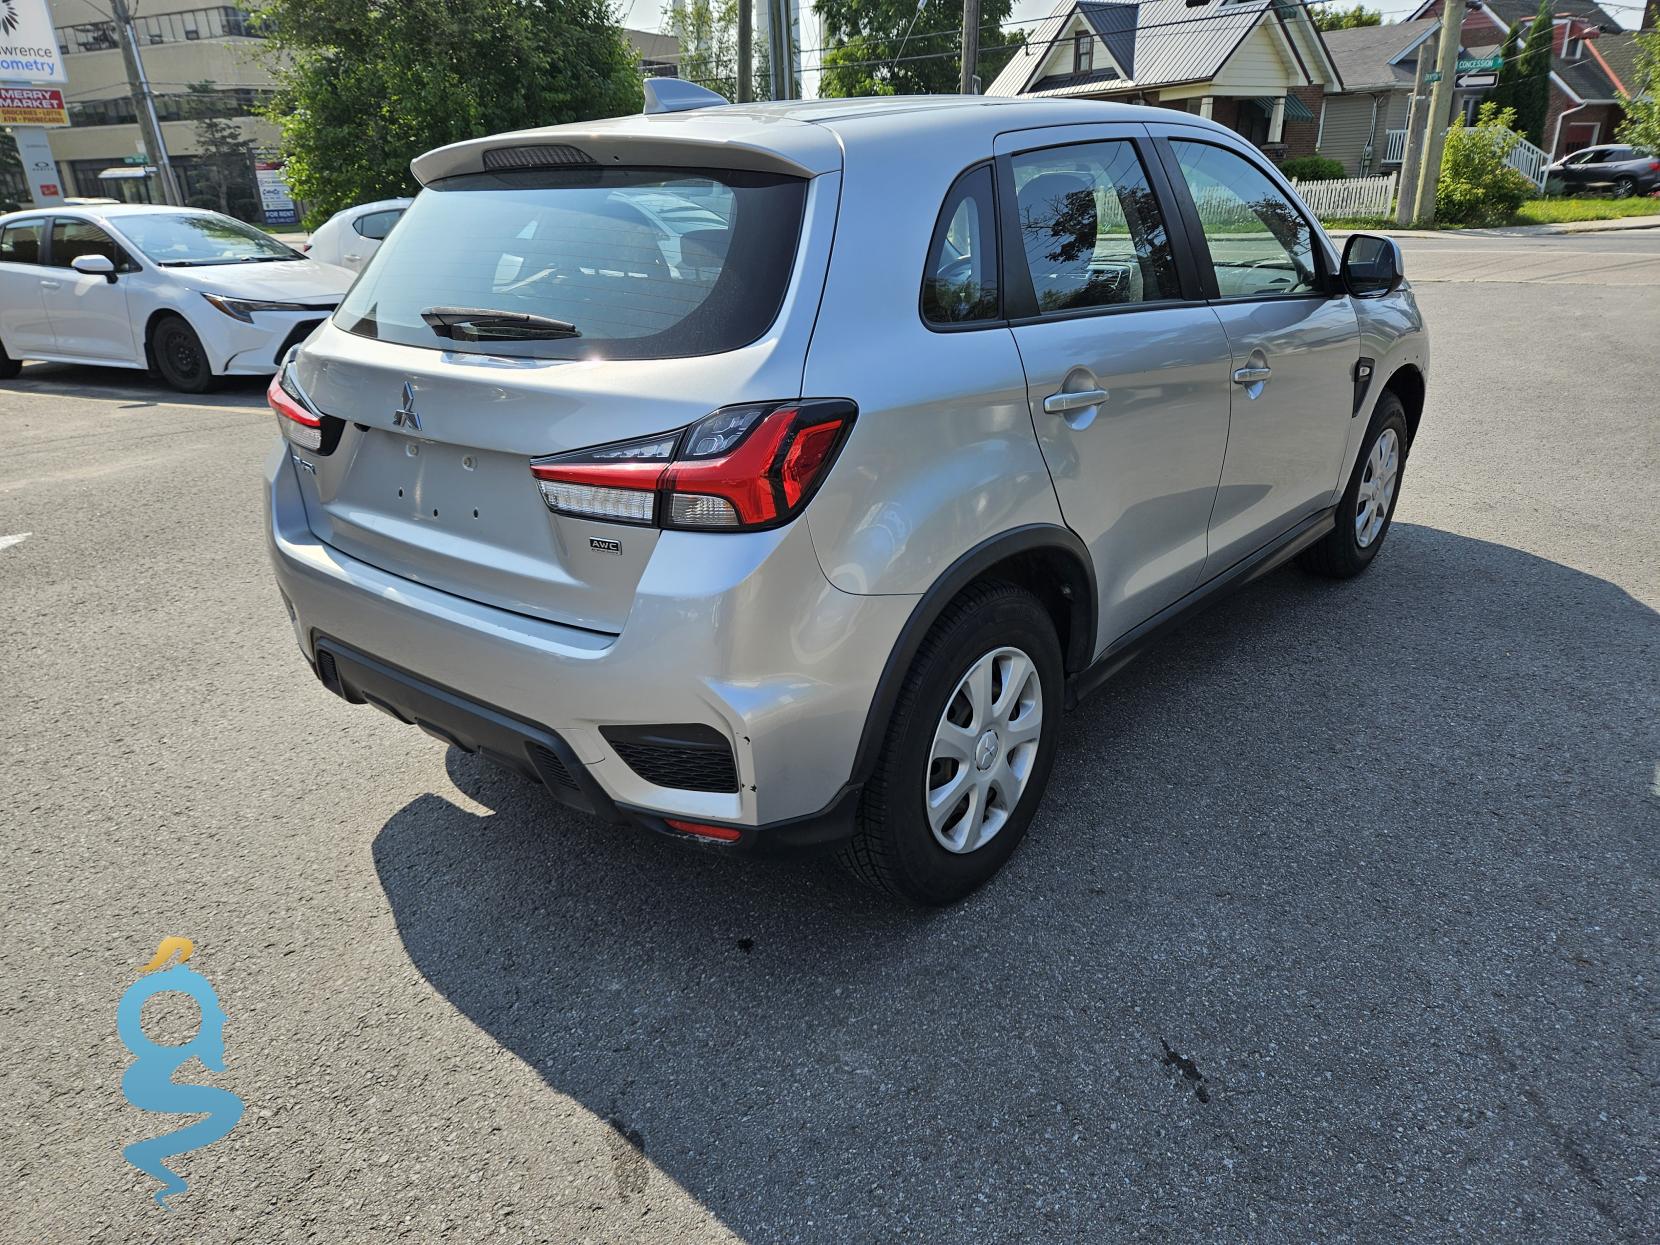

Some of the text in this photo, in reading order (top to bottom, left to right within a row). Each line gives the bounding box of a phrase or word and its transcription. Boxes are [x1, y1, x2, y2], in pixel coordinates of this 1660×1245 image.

[0, 46, 53, 58] wrence
[0, 59, 55, 76] ometry
[1459, 59, 1493, 68] CONCESSION
[0, 89, 52, 100] MERRY
[0, 98, 59, 109] MARKET
[265, 210, 295, 219] FOR RENT
[592, 540, 618, 550] AWC
